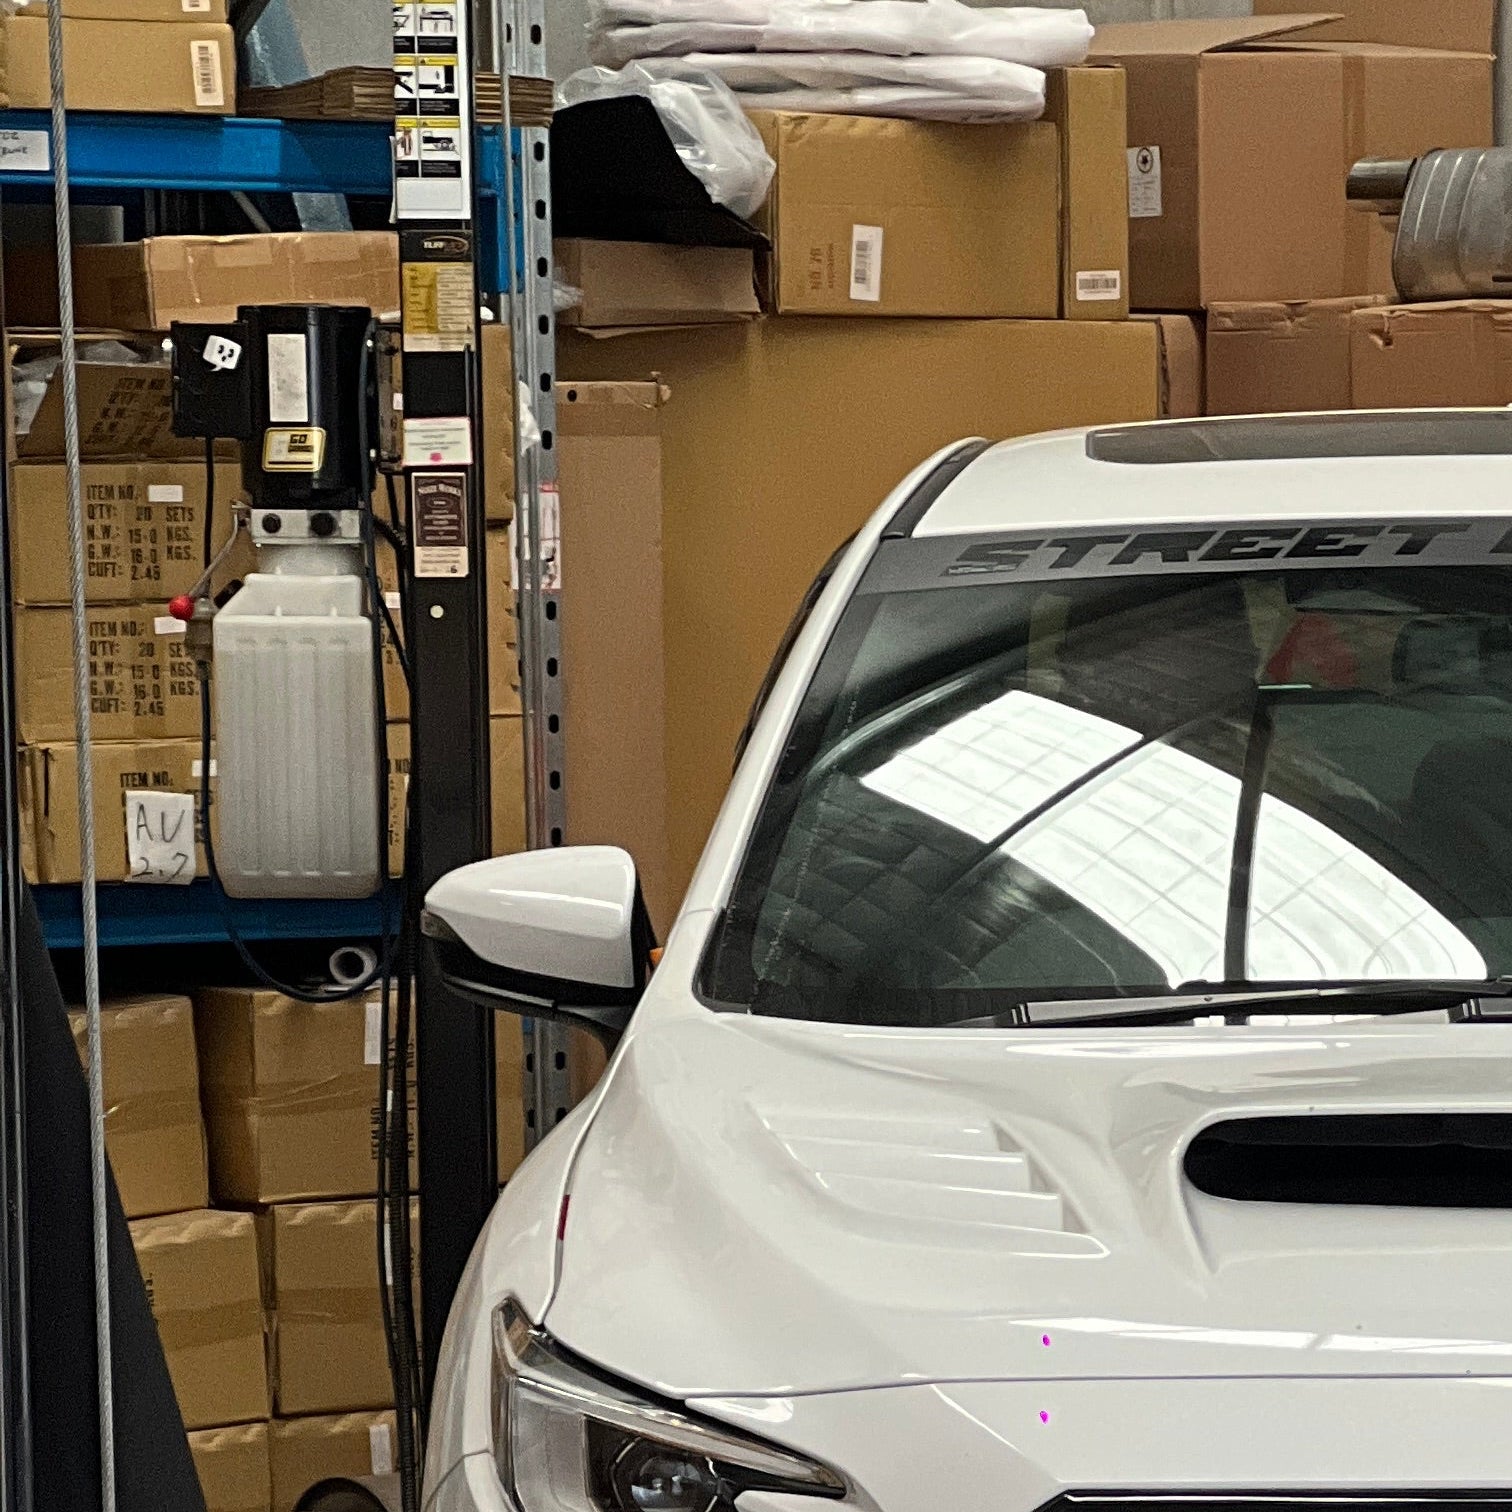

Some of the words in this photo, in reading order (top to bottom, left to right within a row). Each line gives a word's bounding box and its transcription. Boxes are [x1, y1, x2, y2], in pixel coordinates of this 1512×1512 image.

[86, 484, 115, 501] ITEM
[165, 506, 195, 523] SETS
[939, 523, 1472, 577] STREET
[89, 621, 118, 637] ITEM
[168, 641, 183, 658] SE
[120, 771, 149, 788] ITEM
